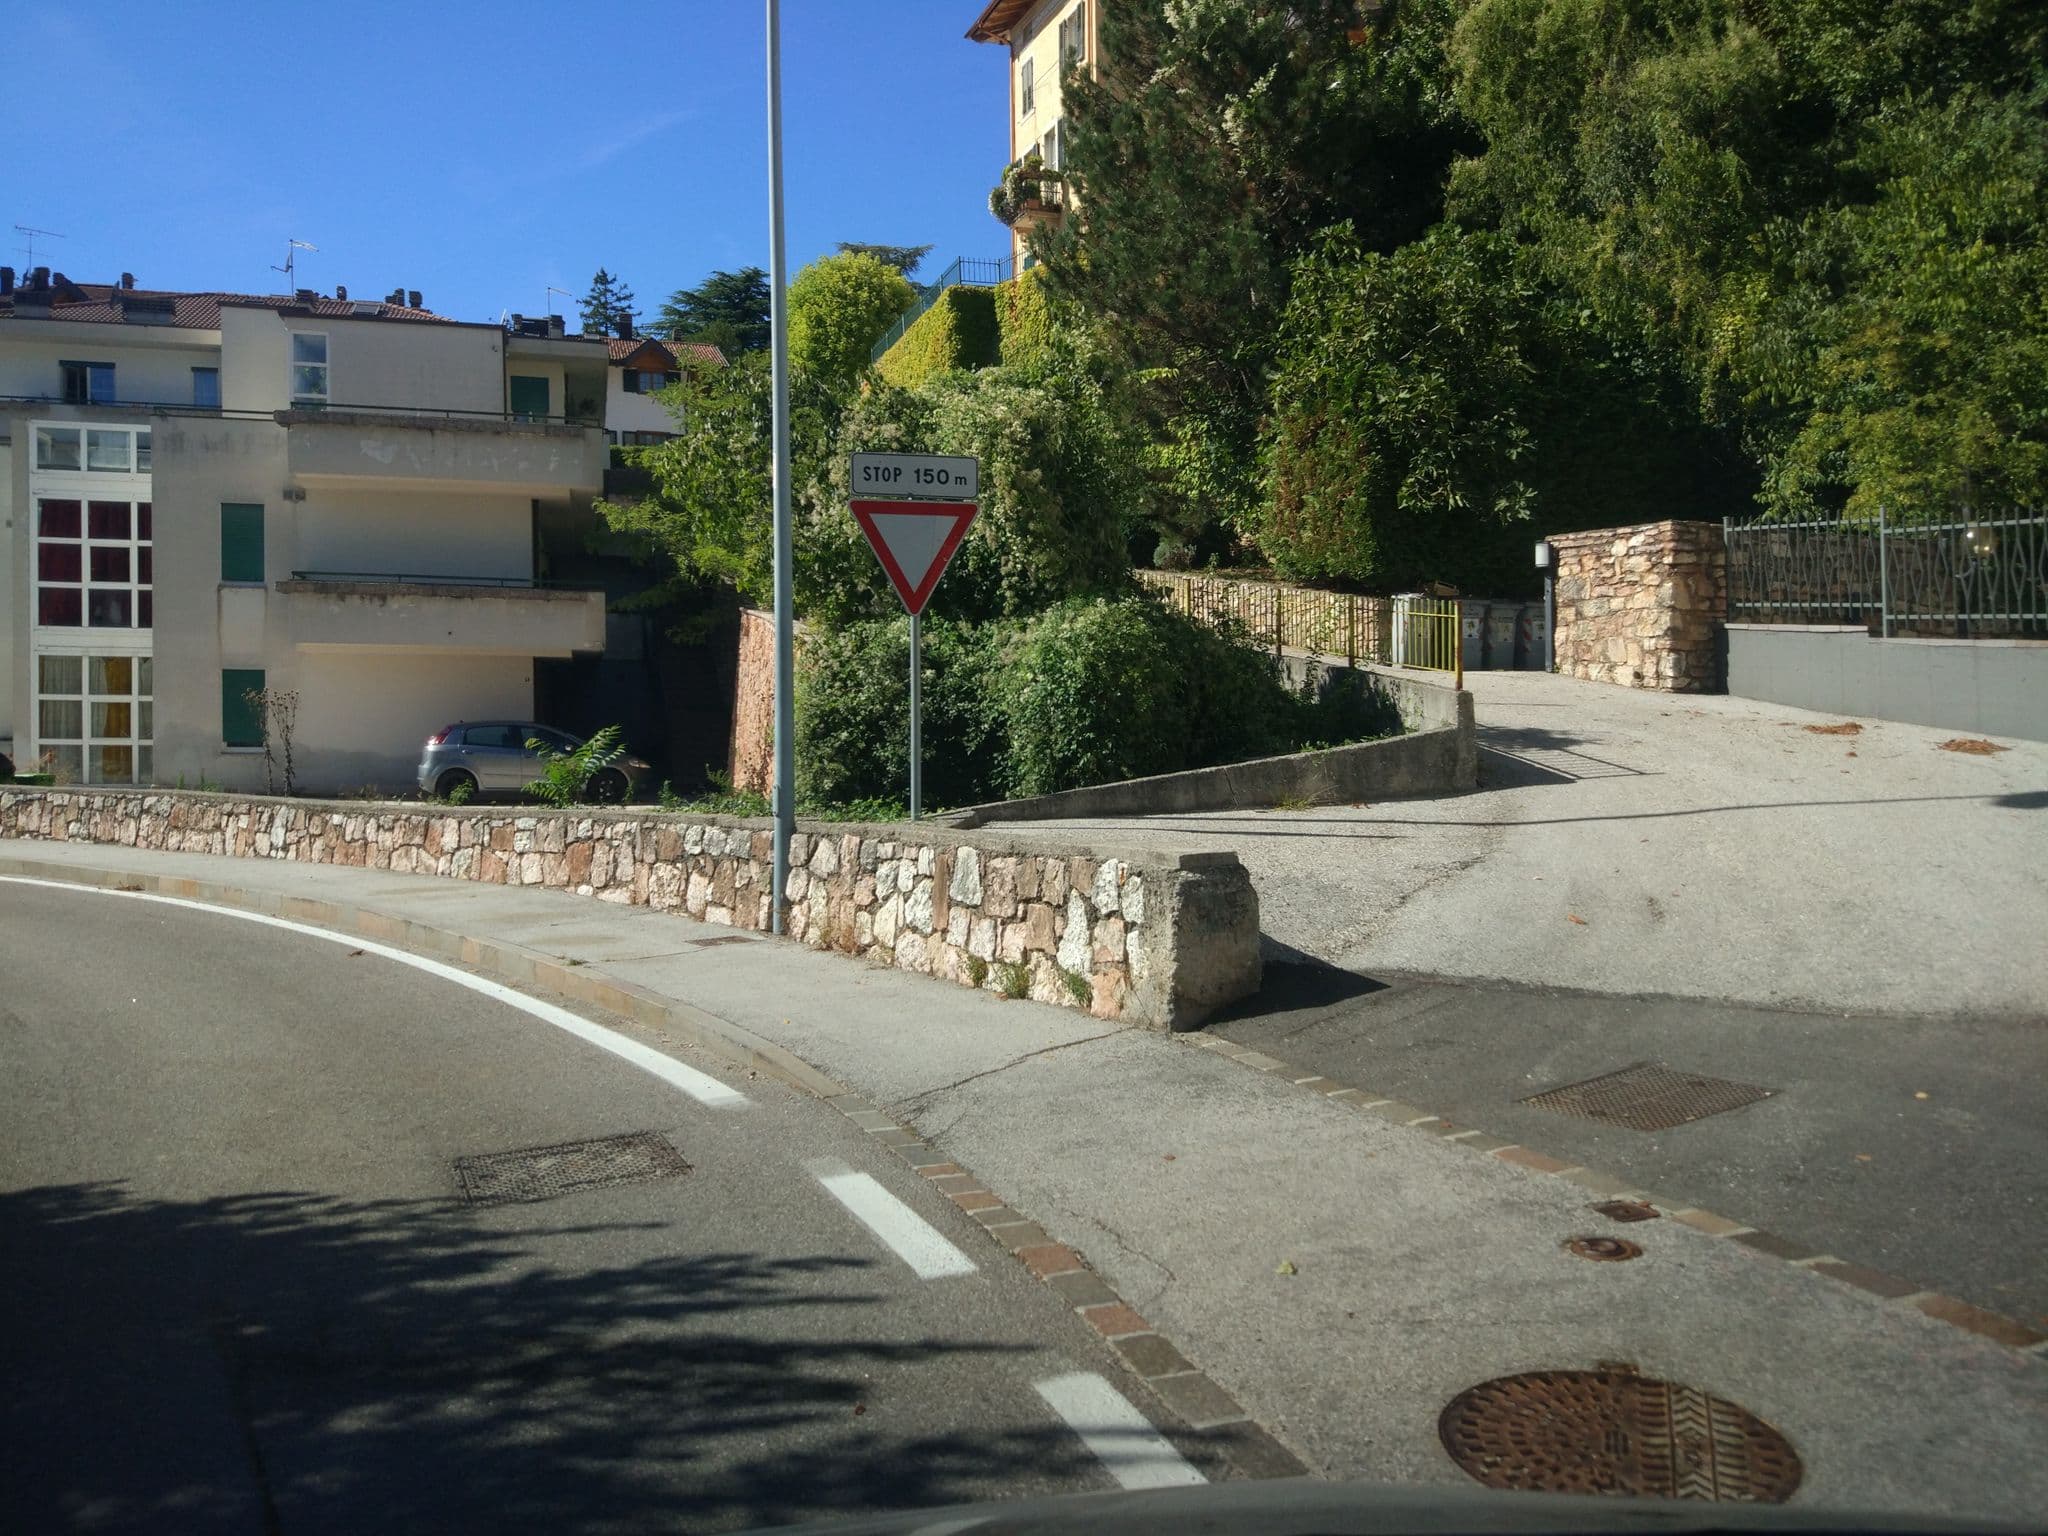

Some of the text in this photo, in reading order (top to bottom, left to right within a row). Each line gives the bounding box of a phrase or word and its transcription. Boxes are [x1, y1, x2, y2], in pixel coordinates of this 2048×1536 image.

[863, 466, 967, 485] STOP 150 m
